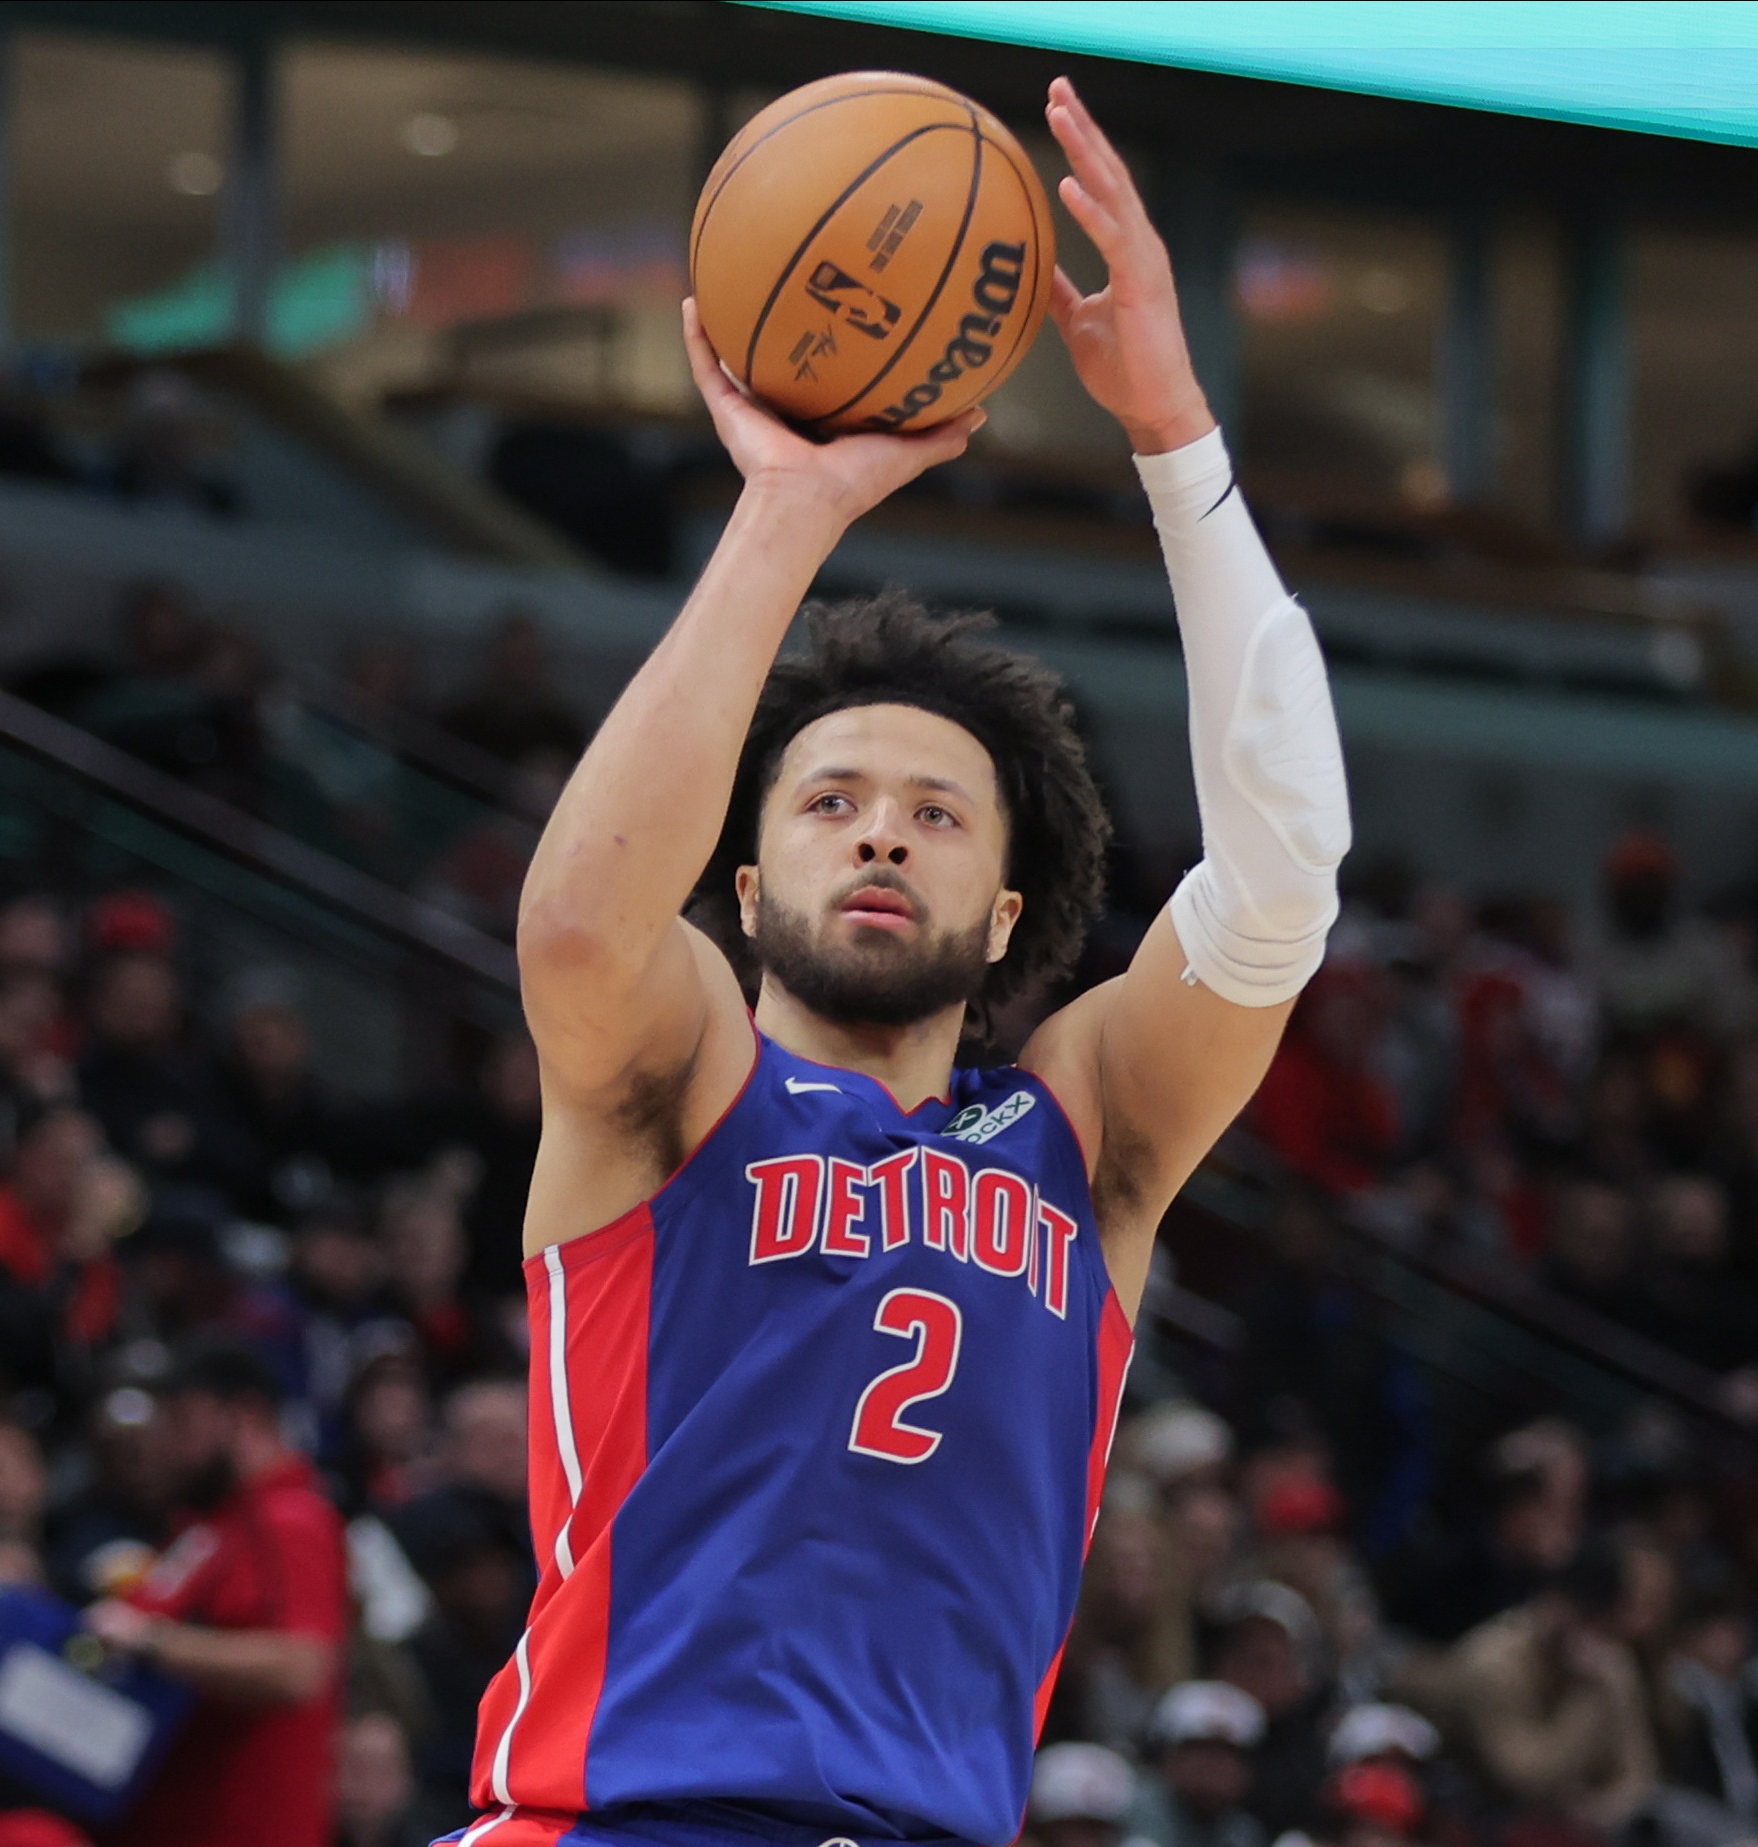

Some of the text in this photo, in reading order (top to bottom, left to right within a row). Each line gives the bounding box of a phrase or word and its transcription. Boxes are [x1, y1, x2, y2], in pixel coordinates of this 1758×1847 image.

[863, 240, 1027, 428] Wilson
[965, 1093, 1030, 1143] ockX
[745, 1145, 1078, 1321] DETROIT
[847, 1287, 962, 1465] 2
